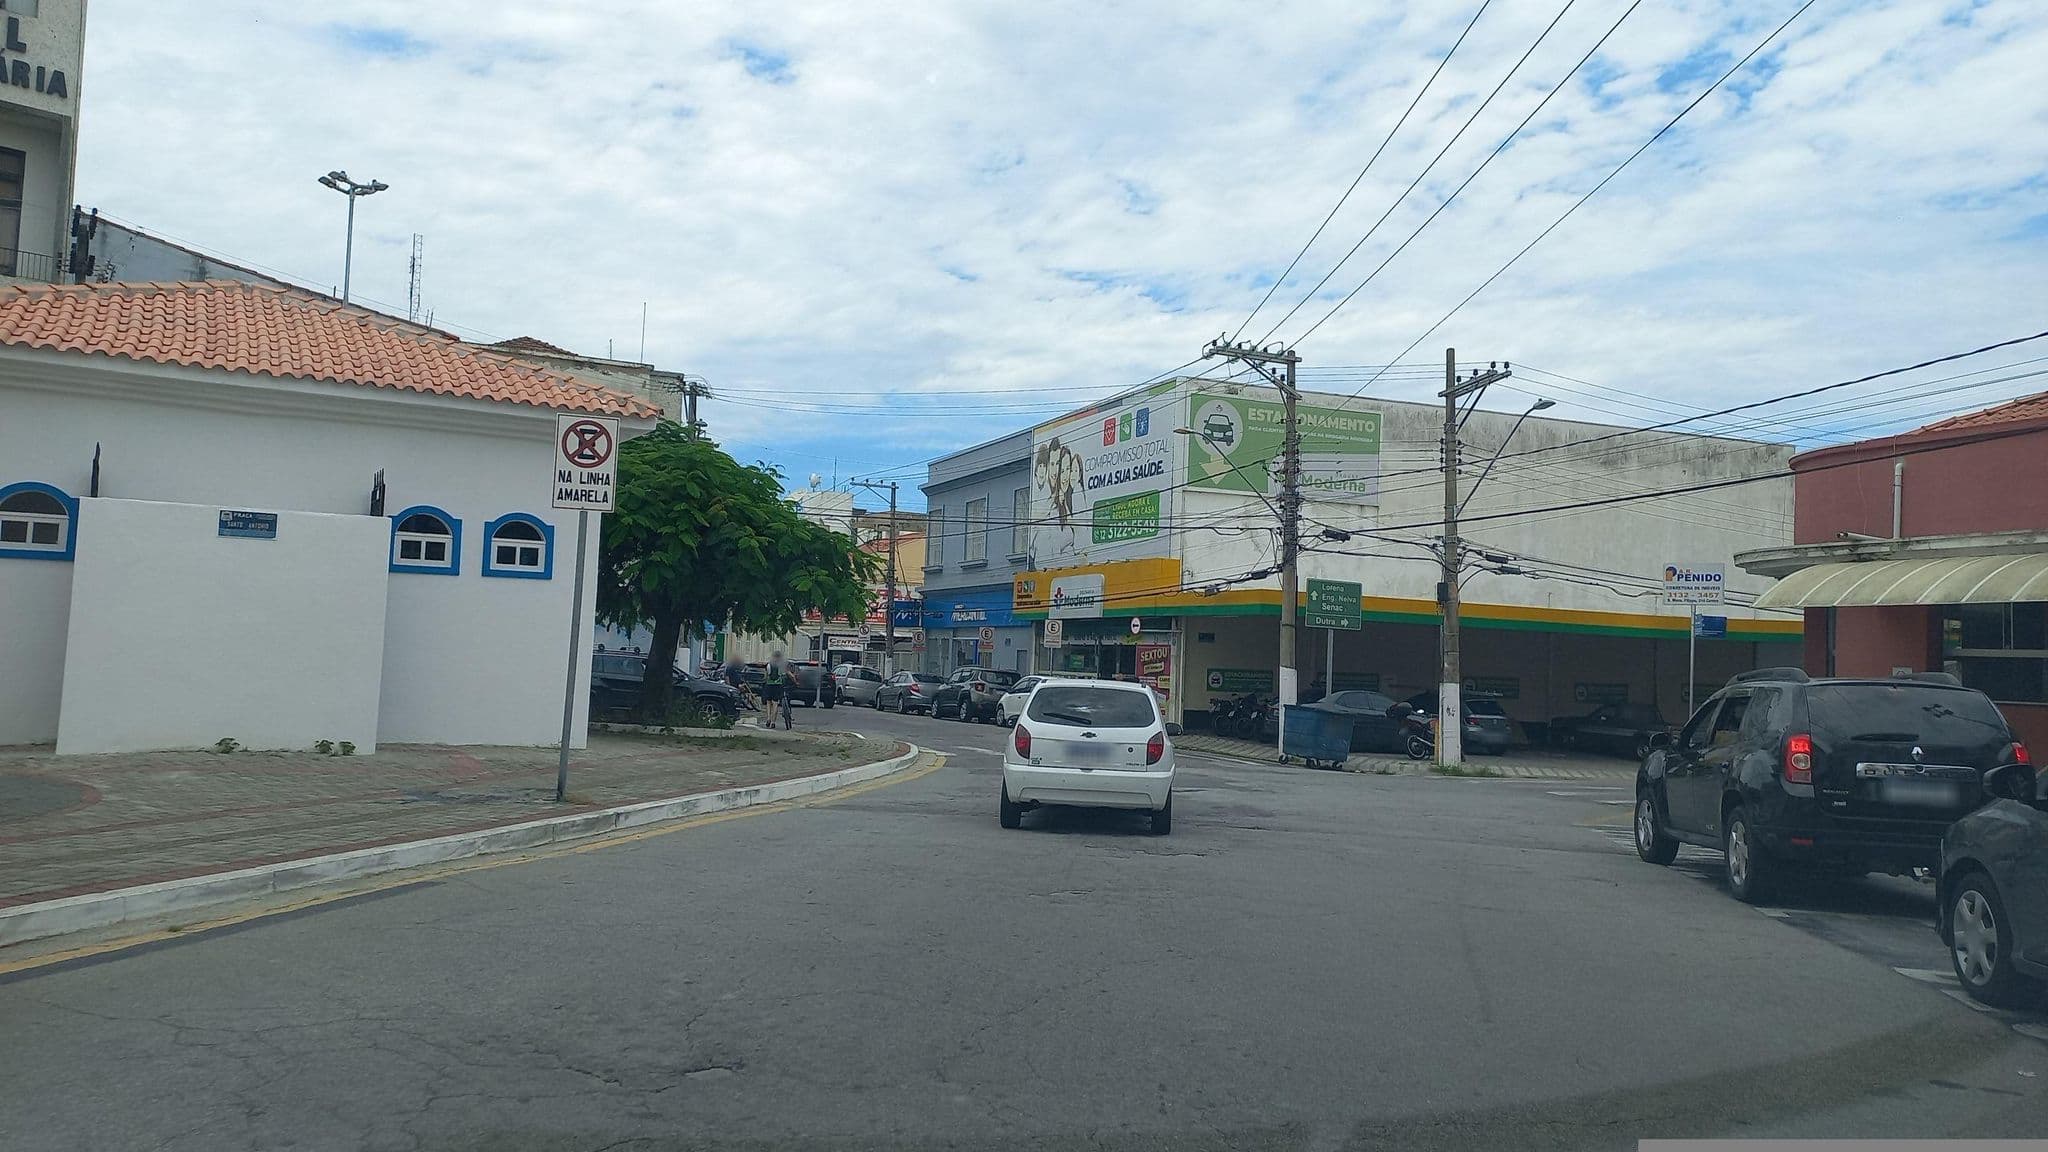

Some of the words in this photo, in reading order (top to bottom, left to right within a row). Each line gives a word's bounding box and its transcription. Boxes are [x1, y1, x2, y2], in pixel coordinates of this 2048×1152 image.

[1248, 408, 1376, 432] ESTAONAMENTO
[1085, 445, 1143, 472] COMPROMISSO
[1145, 438, 1170, 458] TOTAL
[558, 470, 573, 483] NA
[580, 471, 611, 486] LINHA
[1088, 473, 1106, 490] COM
[1107, 472, 1113, 487] A
[1114, 468, 1131, 484] SUA
[1132, 459, 1164, 480] SAÚDE.
[1302, 474, 1365, 492] Moderna
[557, 488, 609, 503] AMARELA
[1677, 573, 1722, 582] PENIDO
[1322, 584, 1344, 592] Lorena
[1322, 603, 1343, 611] Senac
[1316, 617, 1335, 625] Dutra
[1140, 647, 1168, 662] SEXTOU
